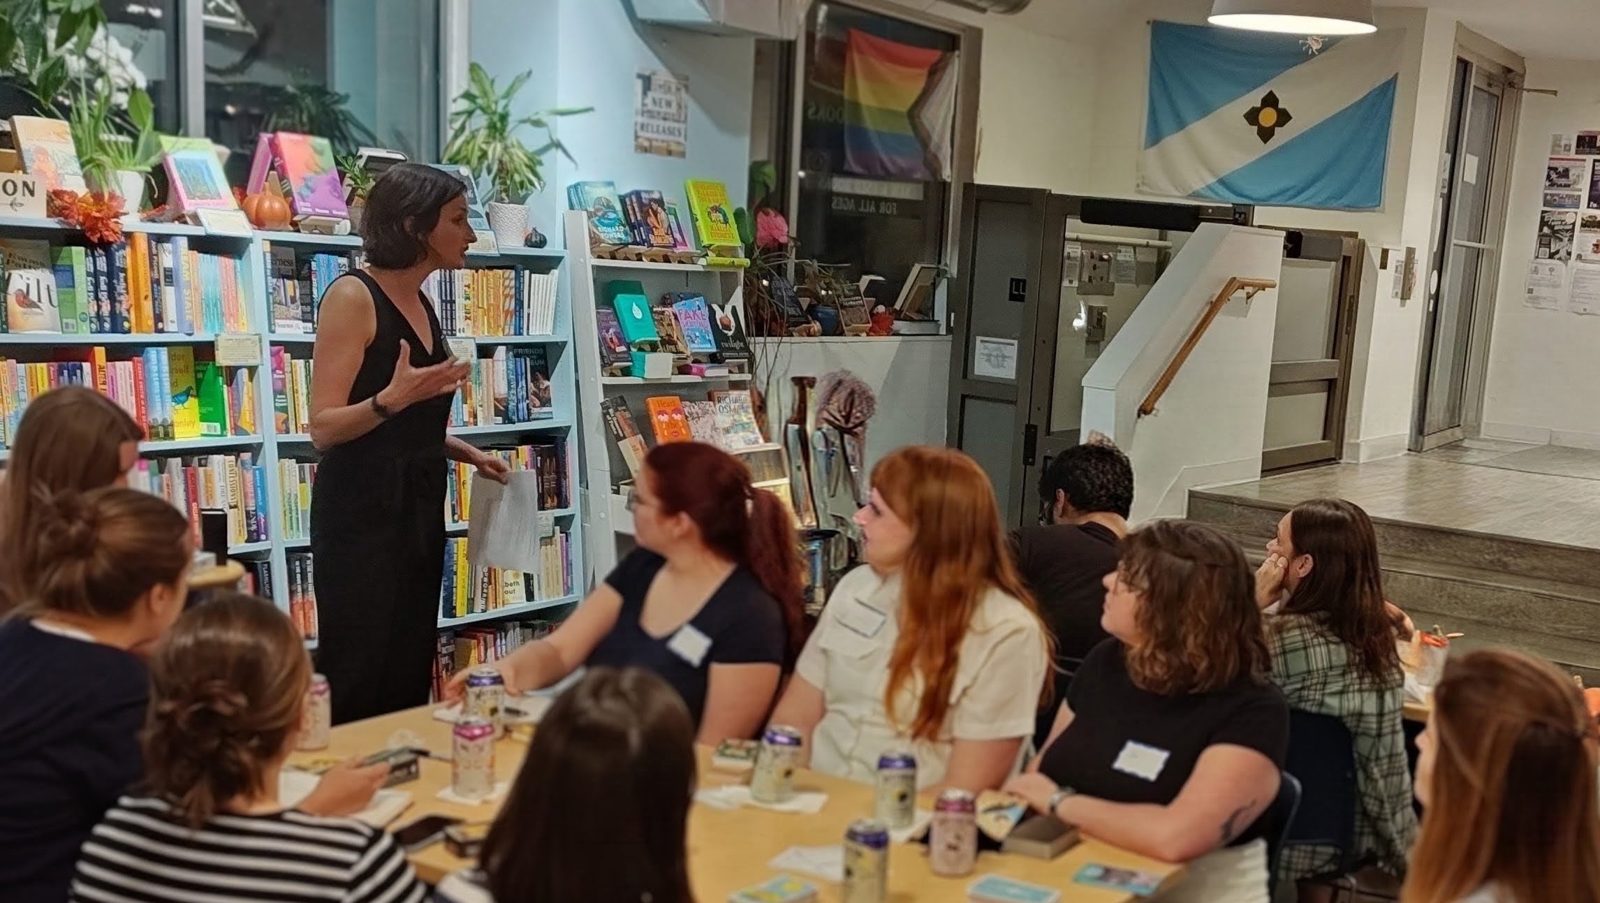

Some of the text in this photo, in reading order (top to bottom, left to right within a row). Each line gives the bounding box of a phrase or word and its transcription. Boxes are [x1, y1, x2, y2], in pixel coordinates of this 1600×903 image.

[651, 96, 673, 110] NEW
[640, 122, 682, 138] RELEASES
[2, 179, 36, 197] ON
